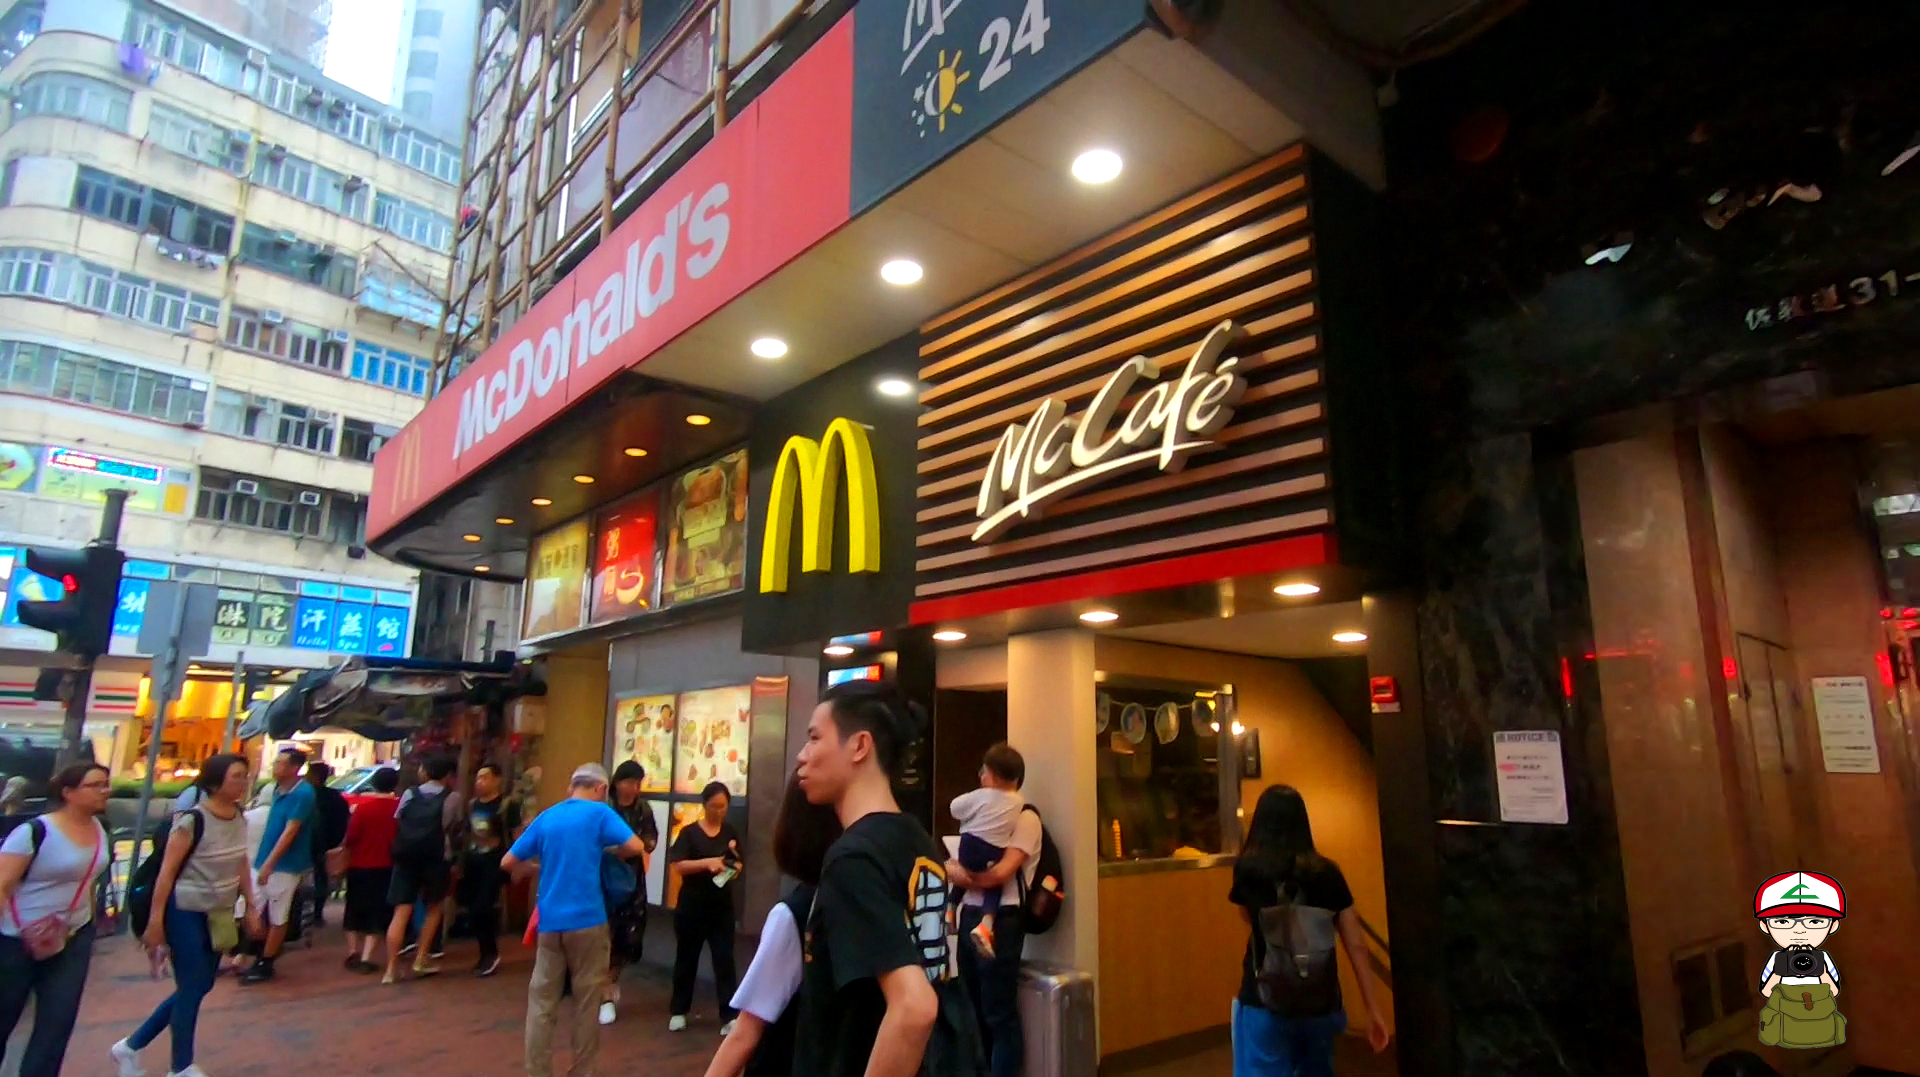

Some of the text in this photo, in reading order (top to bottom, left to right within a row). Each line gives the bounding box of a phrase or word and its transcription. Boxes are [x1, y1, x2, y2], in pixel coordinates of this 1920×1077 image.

[978, 0, 1051, 92] 24
[452, 181, 731, 460] McDonald's
[974, 318, 1242, 520] McCafé
